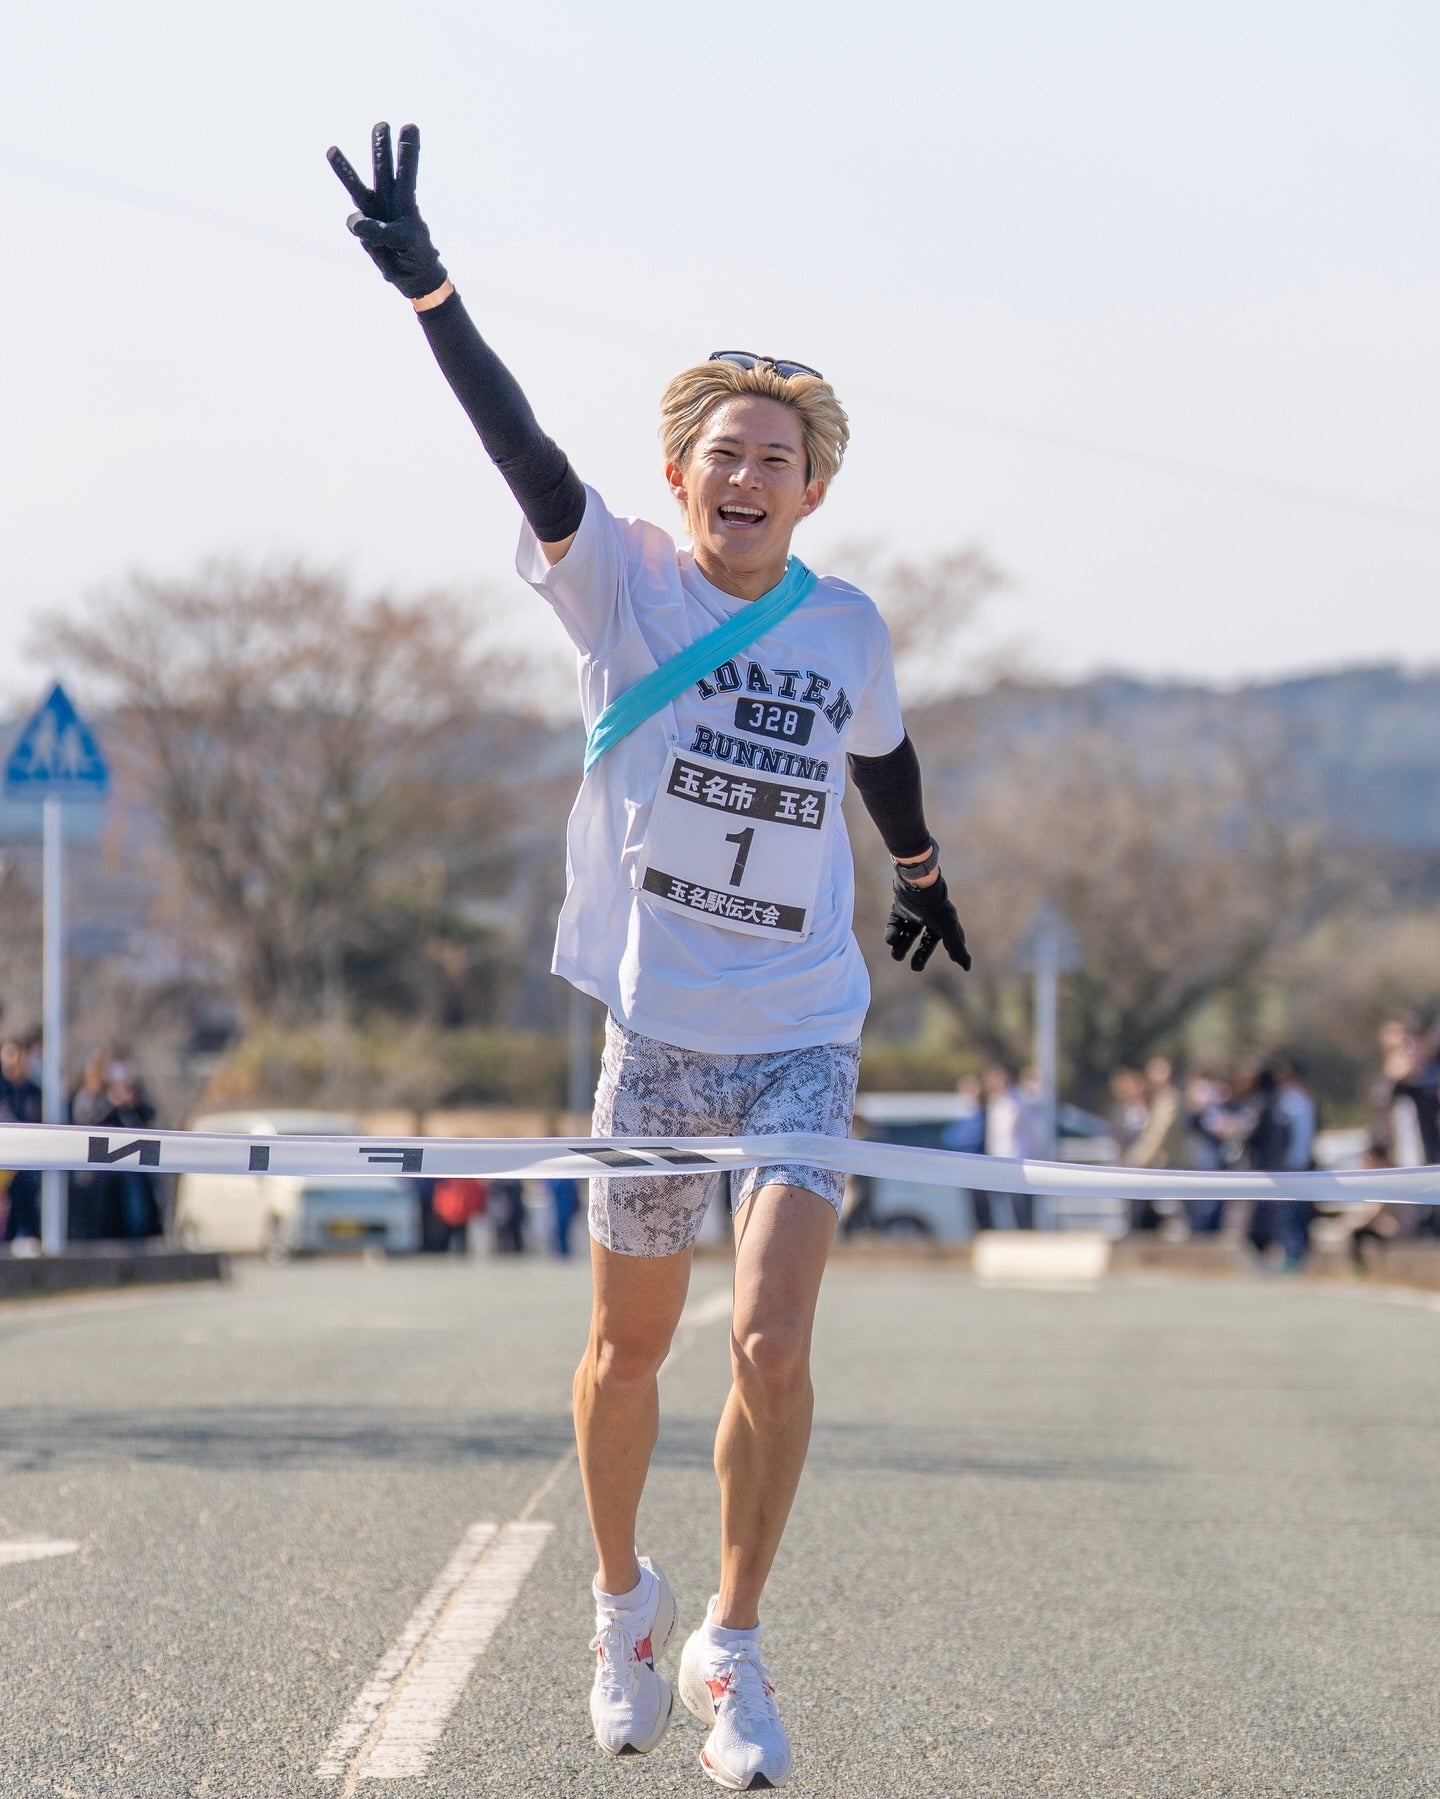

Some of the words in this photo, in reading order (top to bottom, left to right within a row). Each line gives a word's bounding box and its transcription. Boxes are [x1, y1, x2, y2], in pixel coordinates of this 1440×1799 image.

[749, 703, 799, 736] 328
[690, 724, 829, 782] RUNNING
[673, 766, 757, 811] 玉名市
[774, 790, 820, 825] 玉名
[724, 826, 756, 887] 1
[667, 879, 781, 927] 玉名駅伝大会
